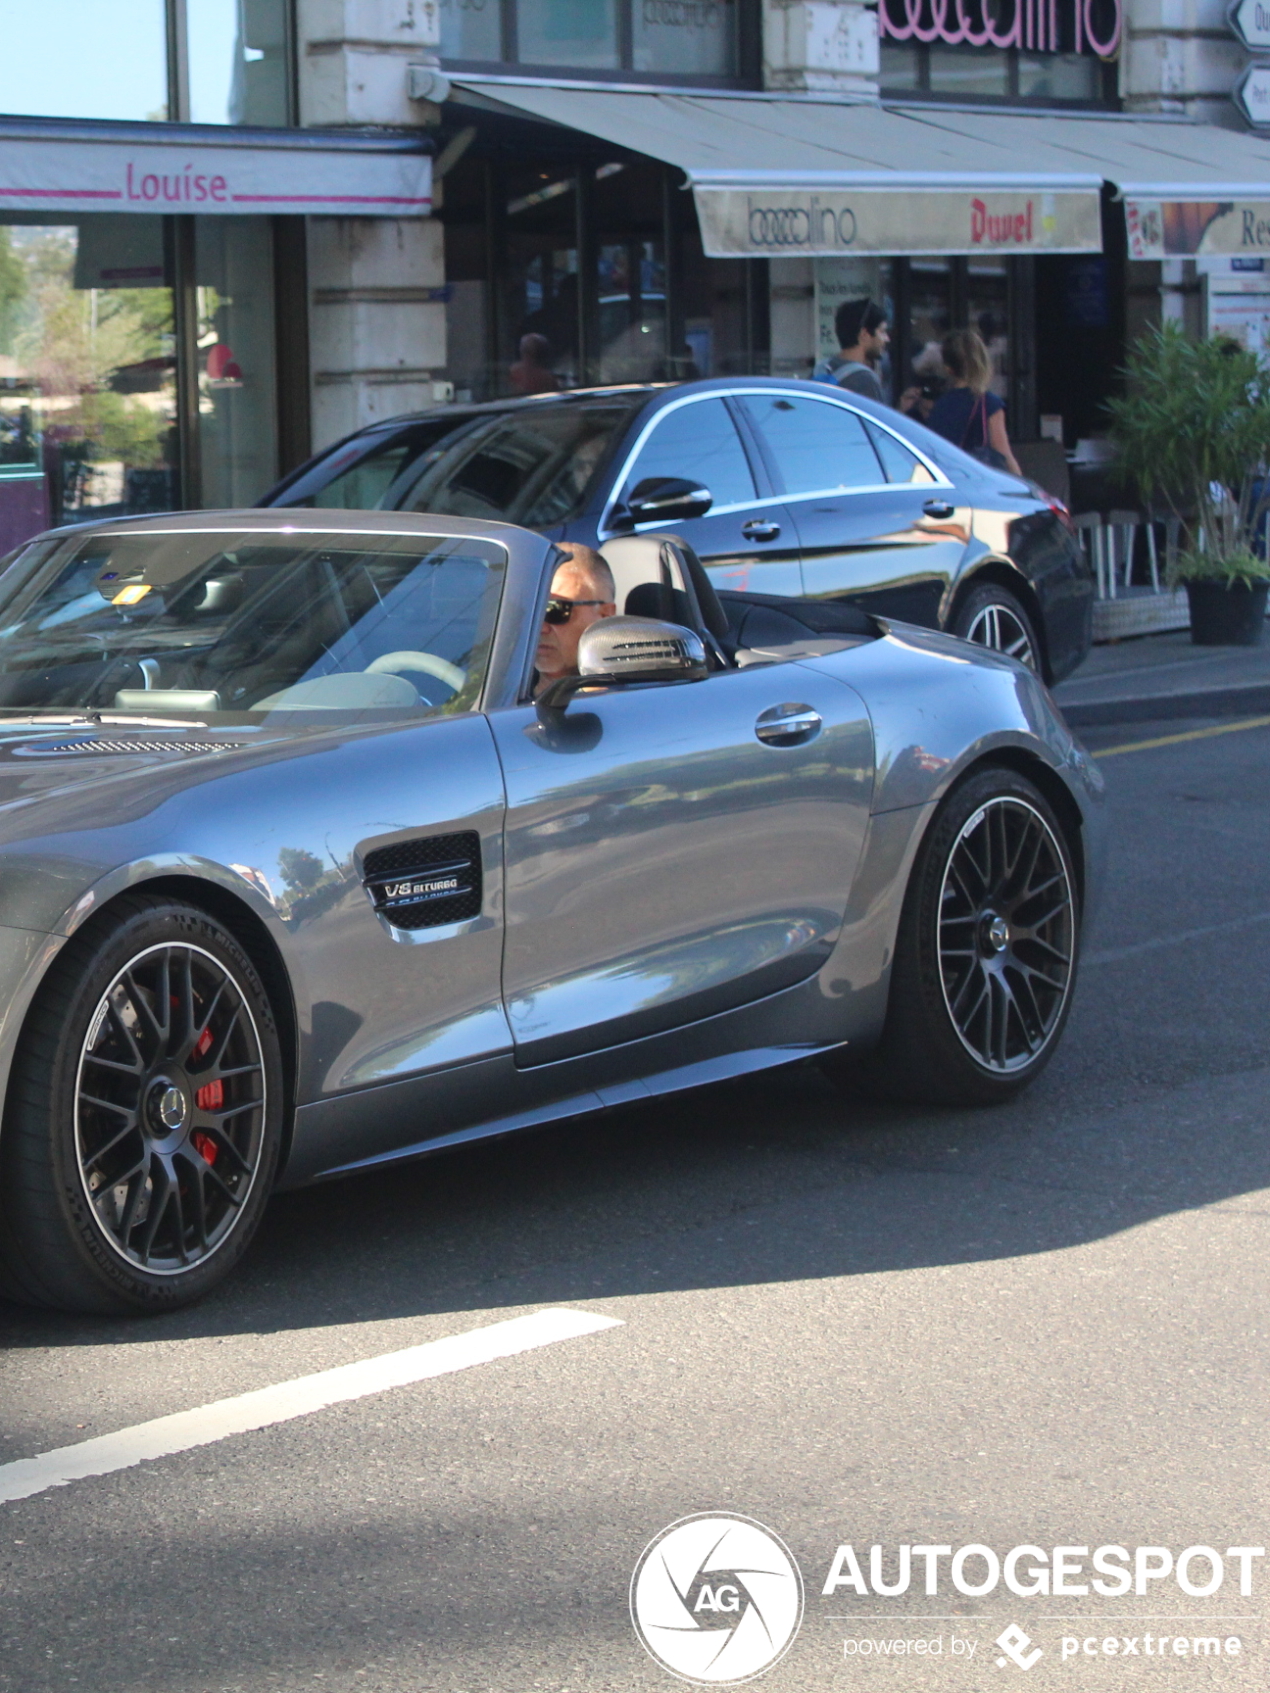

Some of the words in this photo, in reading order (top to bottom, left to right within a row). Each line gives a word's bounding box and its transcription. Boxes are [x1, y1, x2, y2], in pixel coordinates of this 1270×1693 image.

[748, 196, 858, 246] boccalino
[970, 197, 1033, 244] Duvel
[1241, 209, 1270, 246] Re
[385, 882, 411, 897] V8
[413, 879, 458, 893] BITURBO
